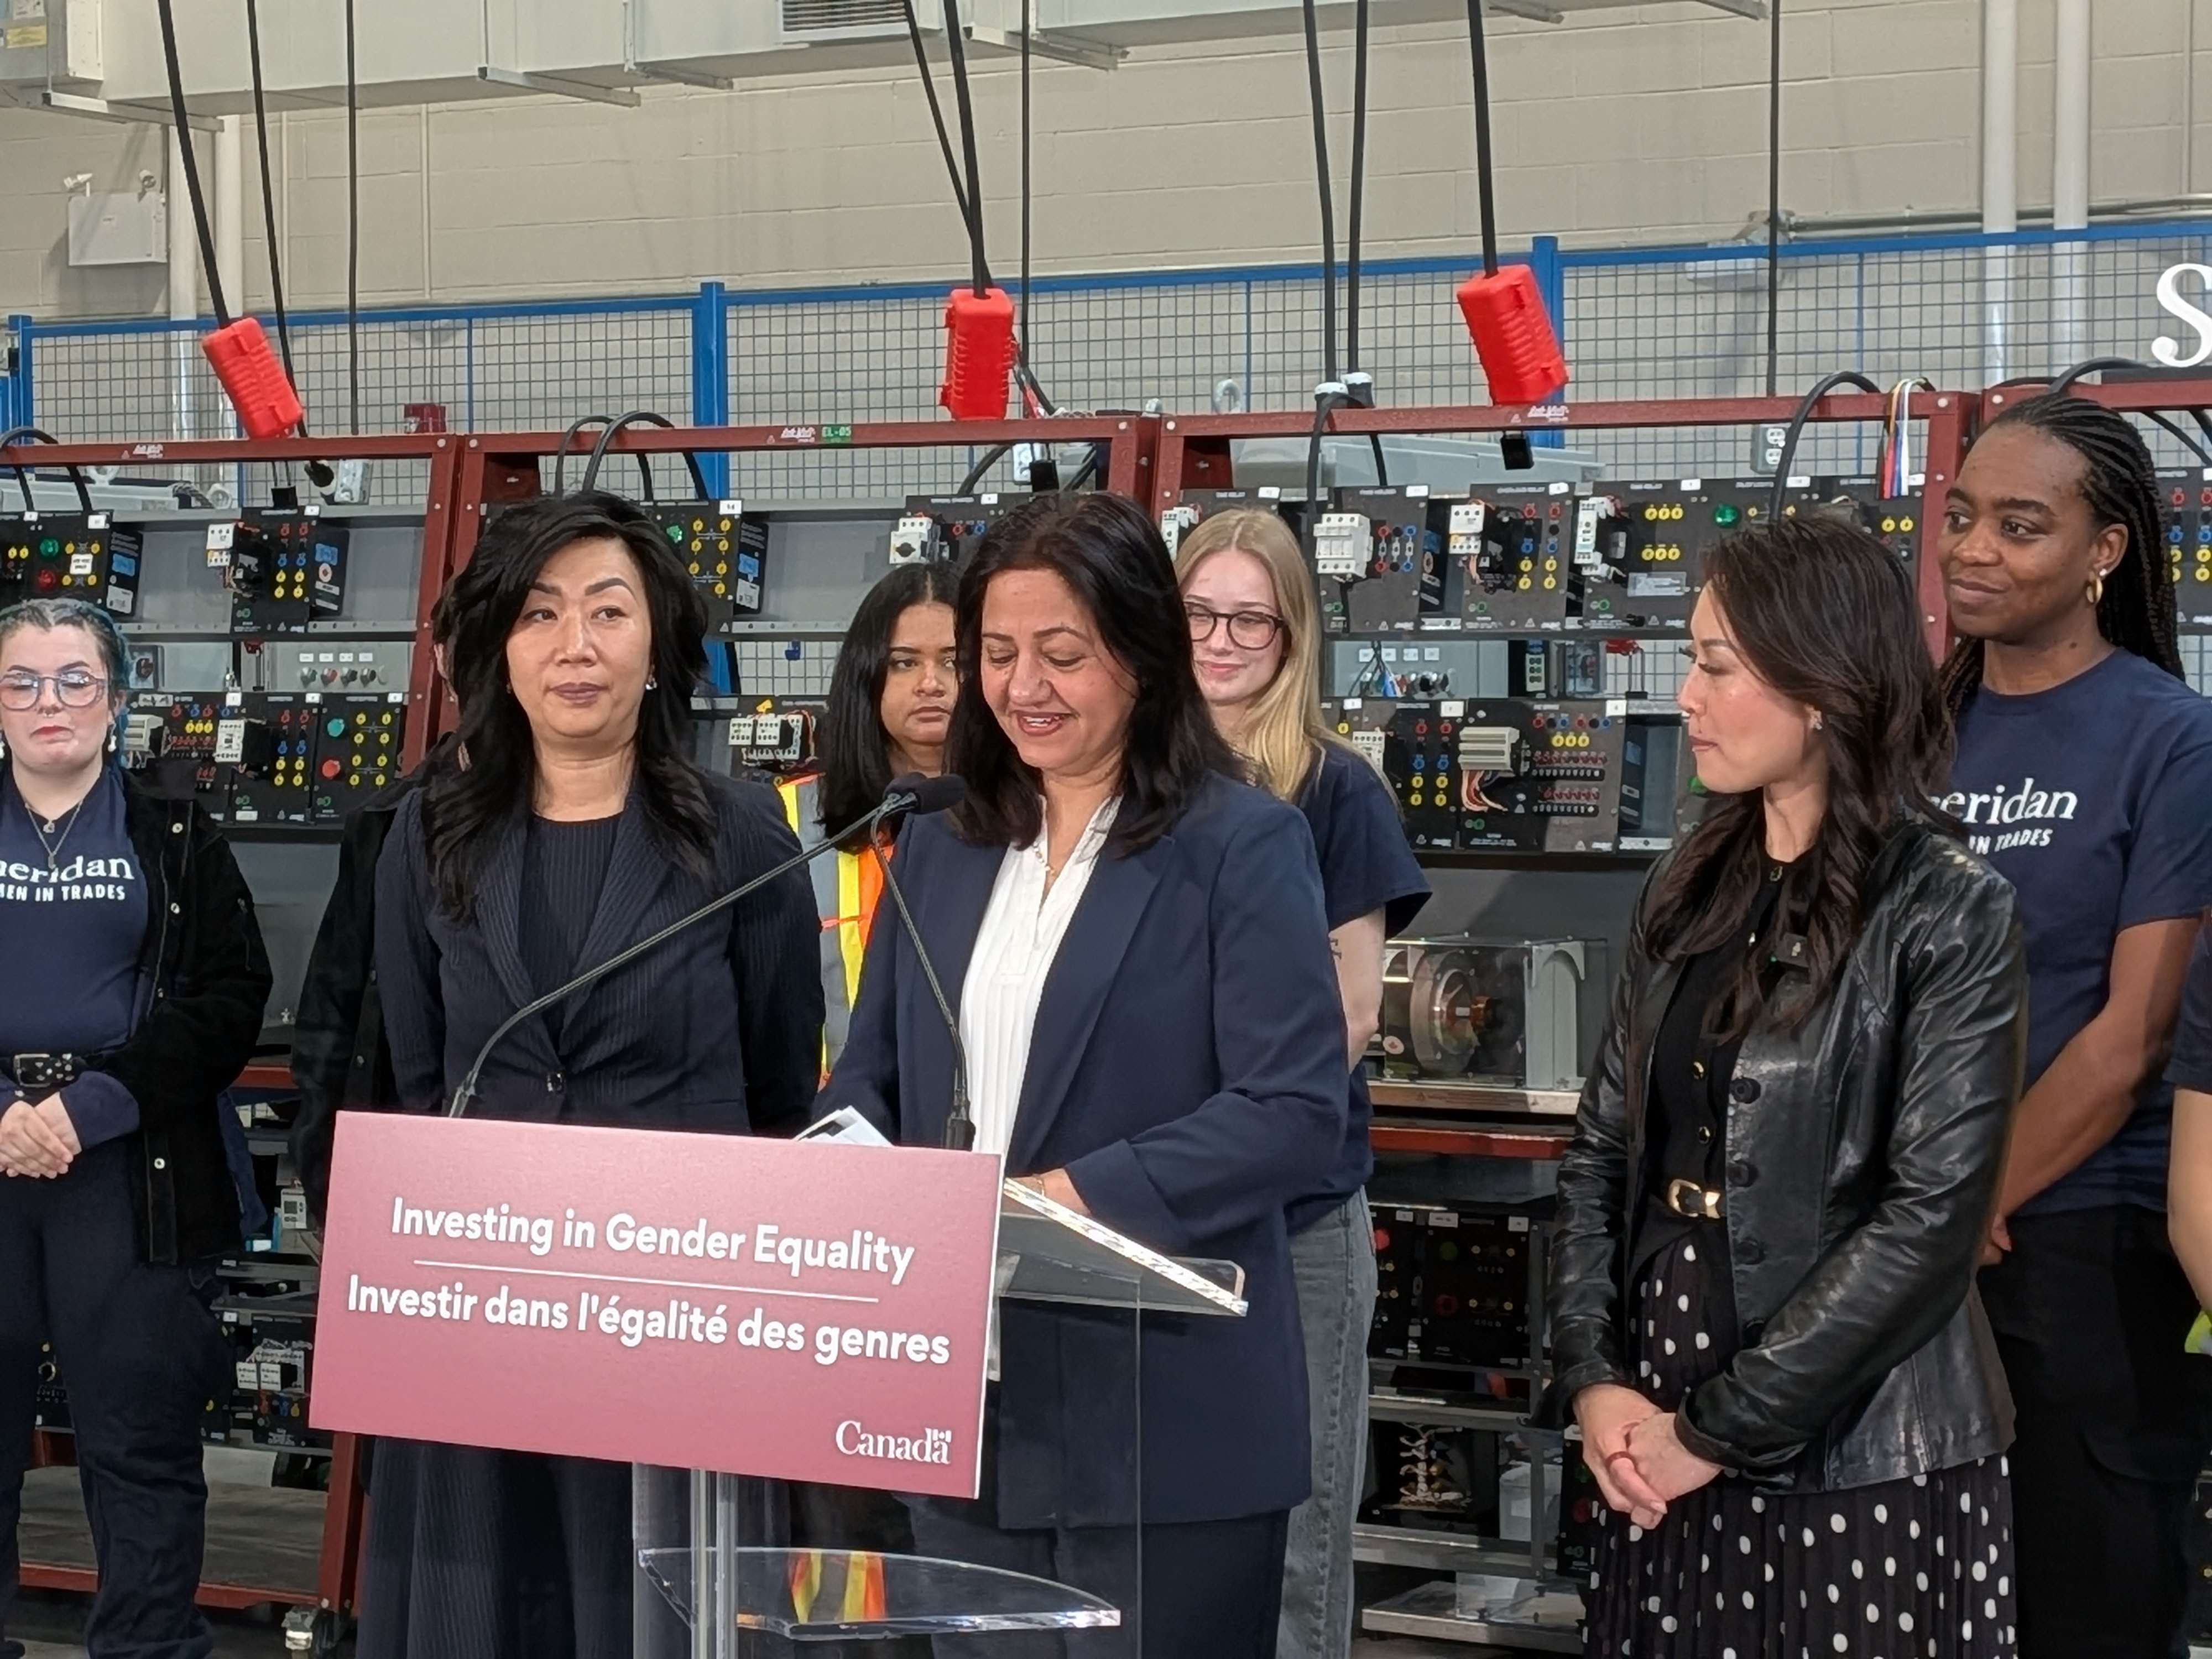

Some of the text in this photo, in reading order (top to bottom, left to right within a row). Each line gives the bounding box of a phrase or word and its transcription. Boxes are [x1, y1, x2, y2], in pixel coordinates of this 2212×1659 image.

[2151, 263, 2212, 367] S
[1929, 777, 2078, 825] eridan
[1994, 828, 2053, 852] TRADES
[35, 886, 54, 902] IN
[61, 883, 126, 901] TRADES
[392, 1196, 915, 1285] Investing in Gender Equality
[348, 1274, 950, 1365] Investir dans l'égalité des genres
[835, 1420, 952, 1465] Canada
